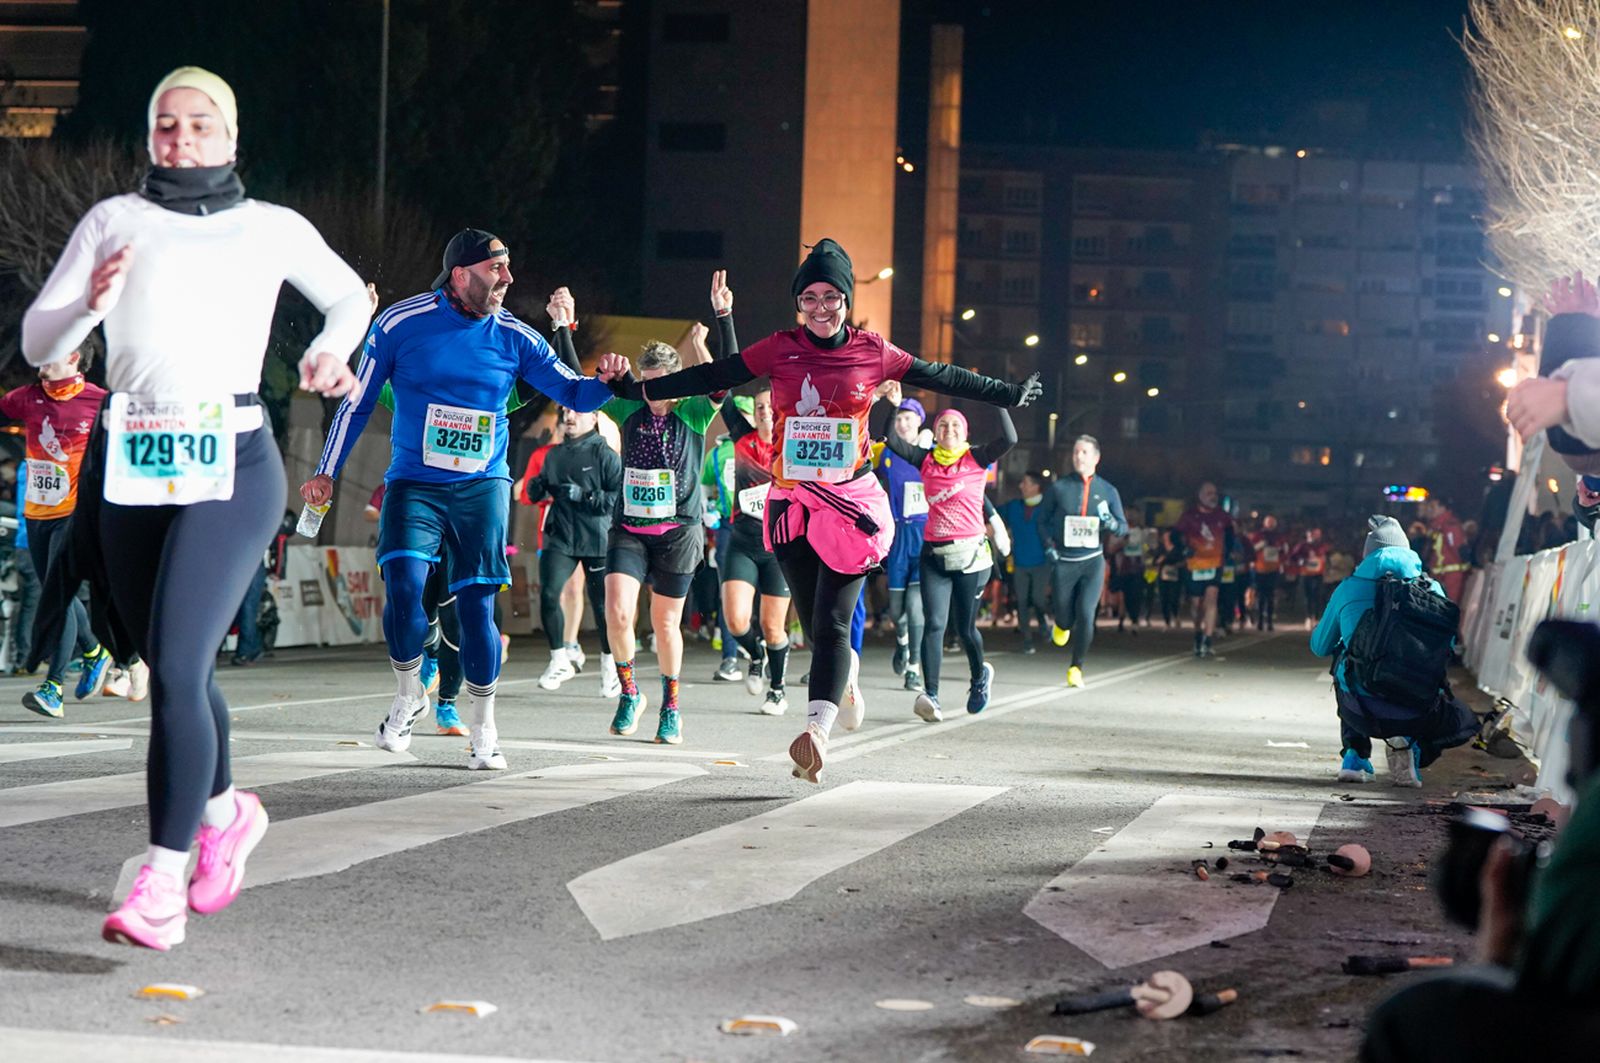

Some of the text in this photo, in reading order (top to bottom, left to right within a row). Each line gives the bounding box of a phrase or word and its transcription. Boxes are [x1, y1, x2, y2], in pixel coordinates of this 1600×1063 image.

[126, 421, 145, 431] SAN
[433, 419, 448, 427] SAN
[436, 428, 483, 453] 3255
[792, 432, 806, 440] SAN
[46, 441, 58, 454] 43
[126, 434, 217, 466] 12930
[796, 440, 844, 461] 3254
[632, 486, 665, 502] 8236
[750, 500, 766, 512] 26
[347, 571, 369, 593] SAN
